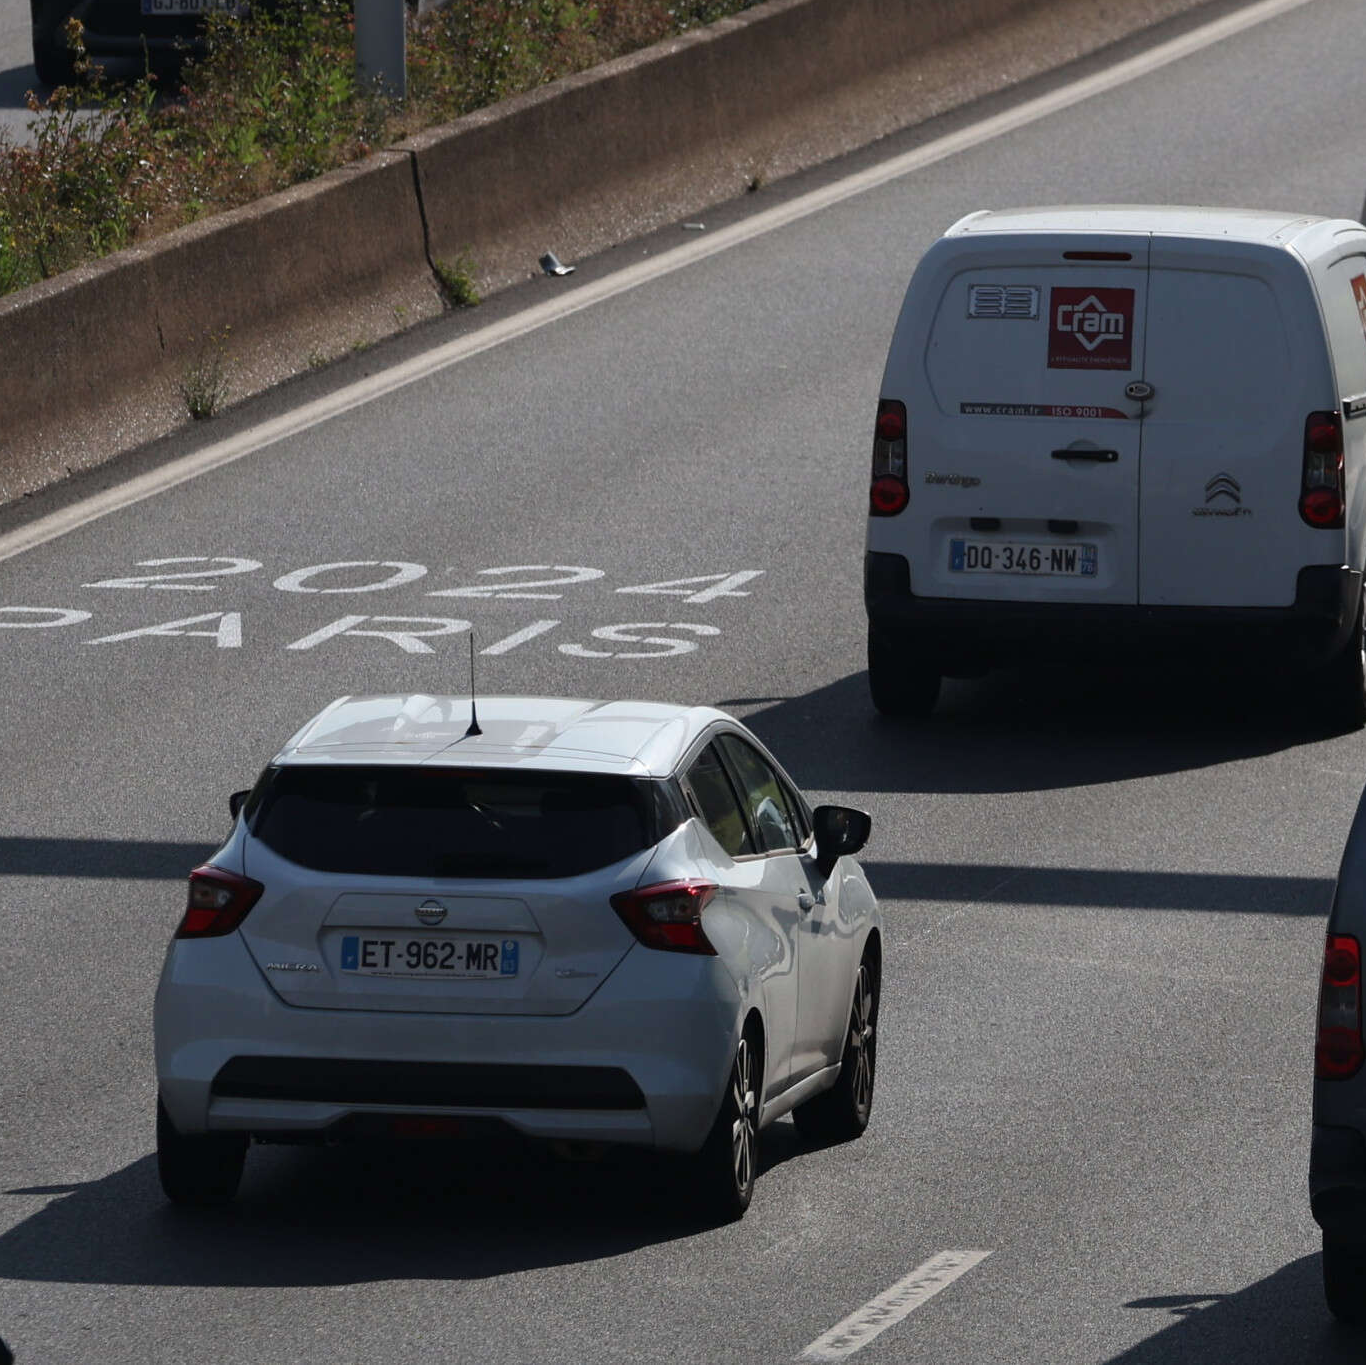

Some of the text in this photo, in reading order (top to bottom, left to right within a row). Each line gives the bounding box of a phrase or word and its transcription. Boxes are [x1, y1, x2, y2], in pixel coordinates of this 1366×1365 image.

[963, 404, 1040, 416] www.cram.fr
[1051, 407, 1103, 418] ISO 9001
[80, 556, 767, 603] 2024
[360, 940, 499, 971] ET-962-MR
